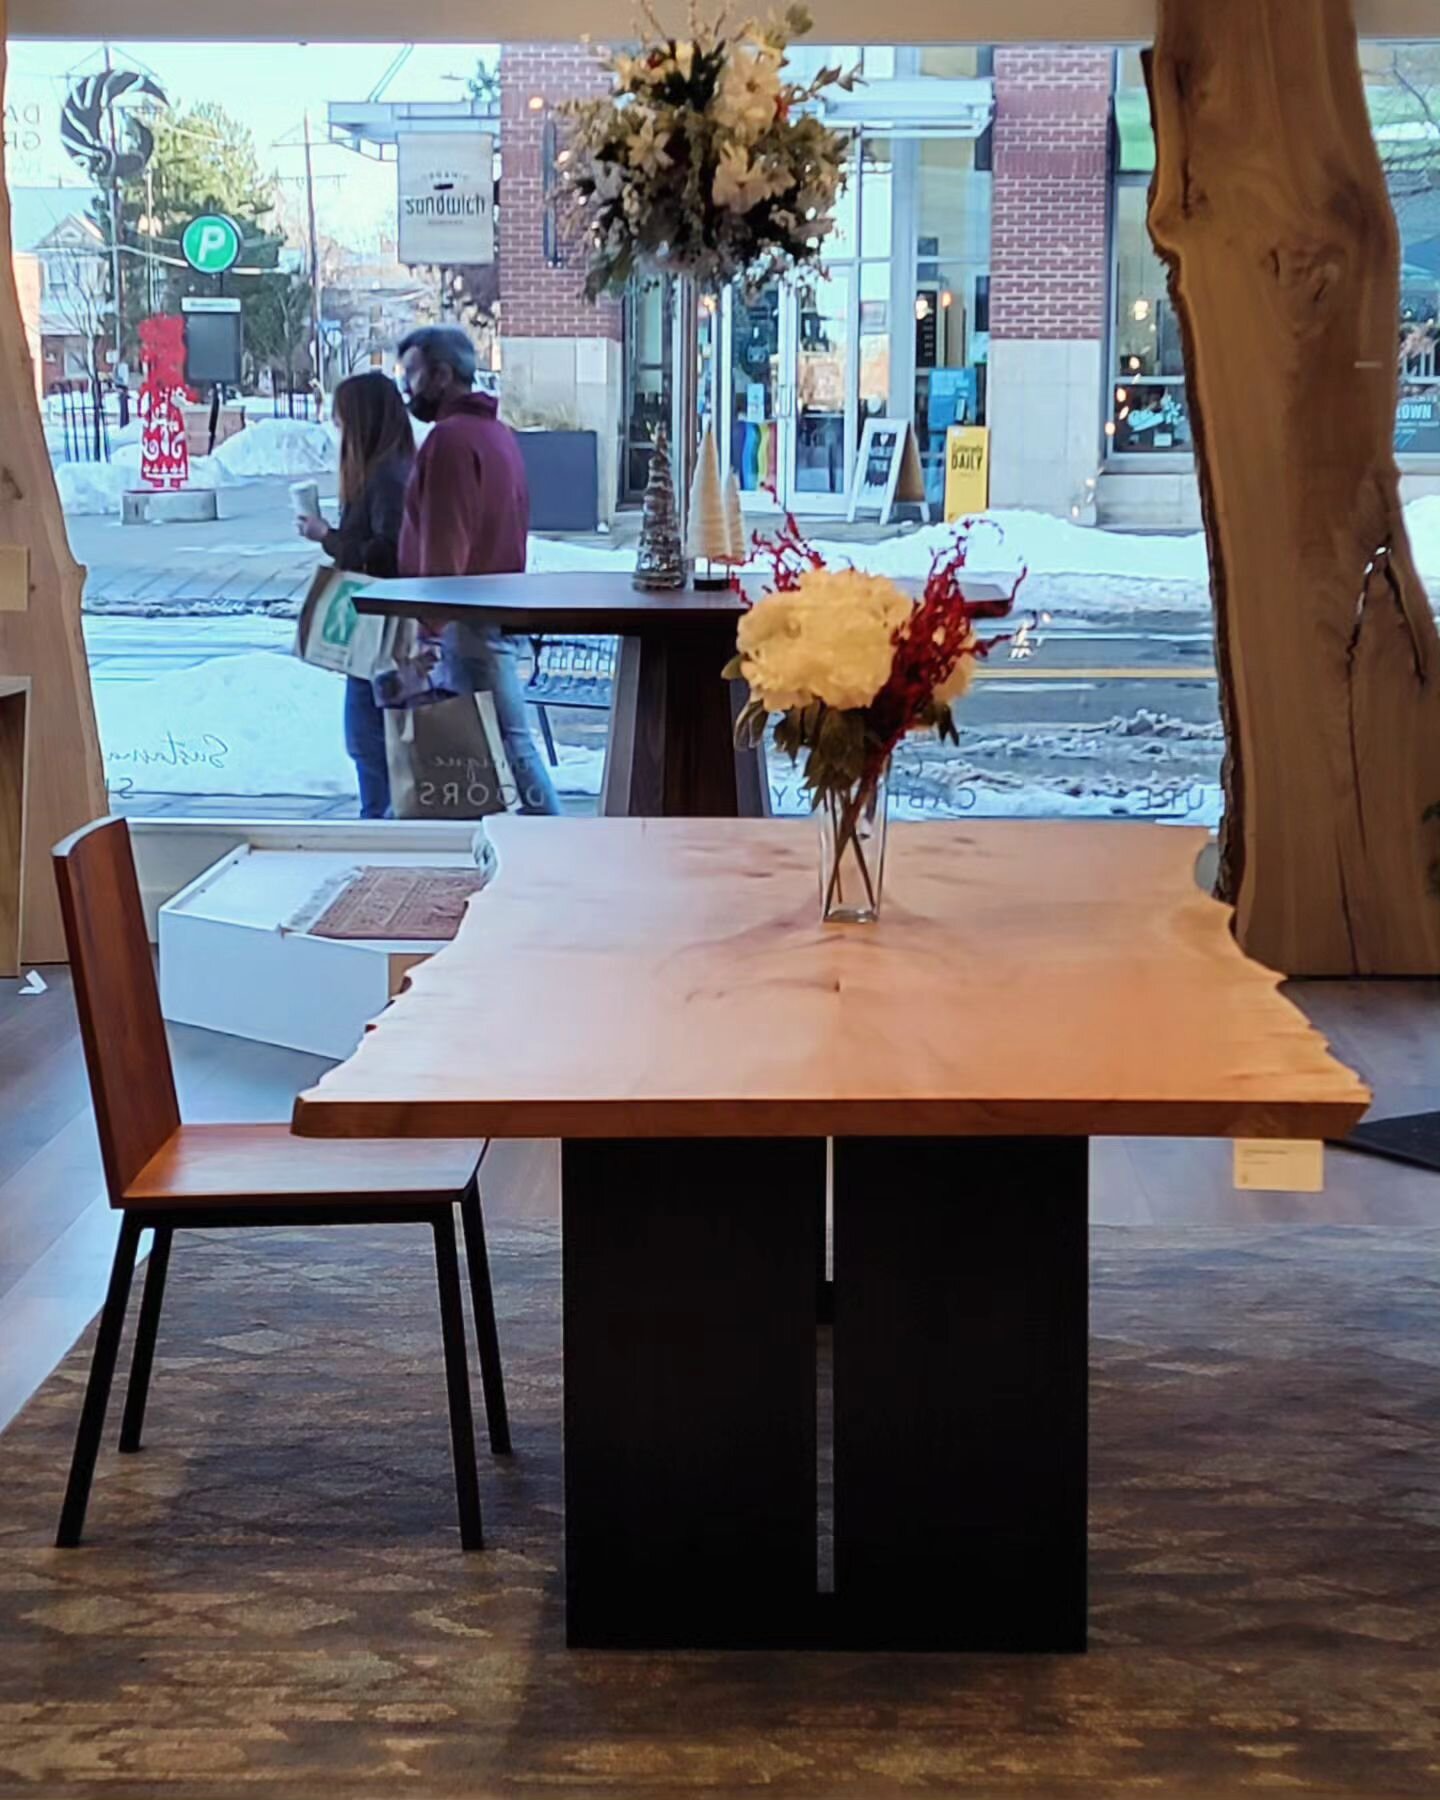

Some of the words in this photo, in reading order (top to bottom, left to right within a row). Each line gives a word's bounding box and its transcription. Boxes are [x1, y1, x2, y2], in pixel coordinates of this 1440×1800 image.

[405, 193, 485, 216] sandwich
[197, 225, 226, 263] P
[951, 451, 984, 471] DAILY
